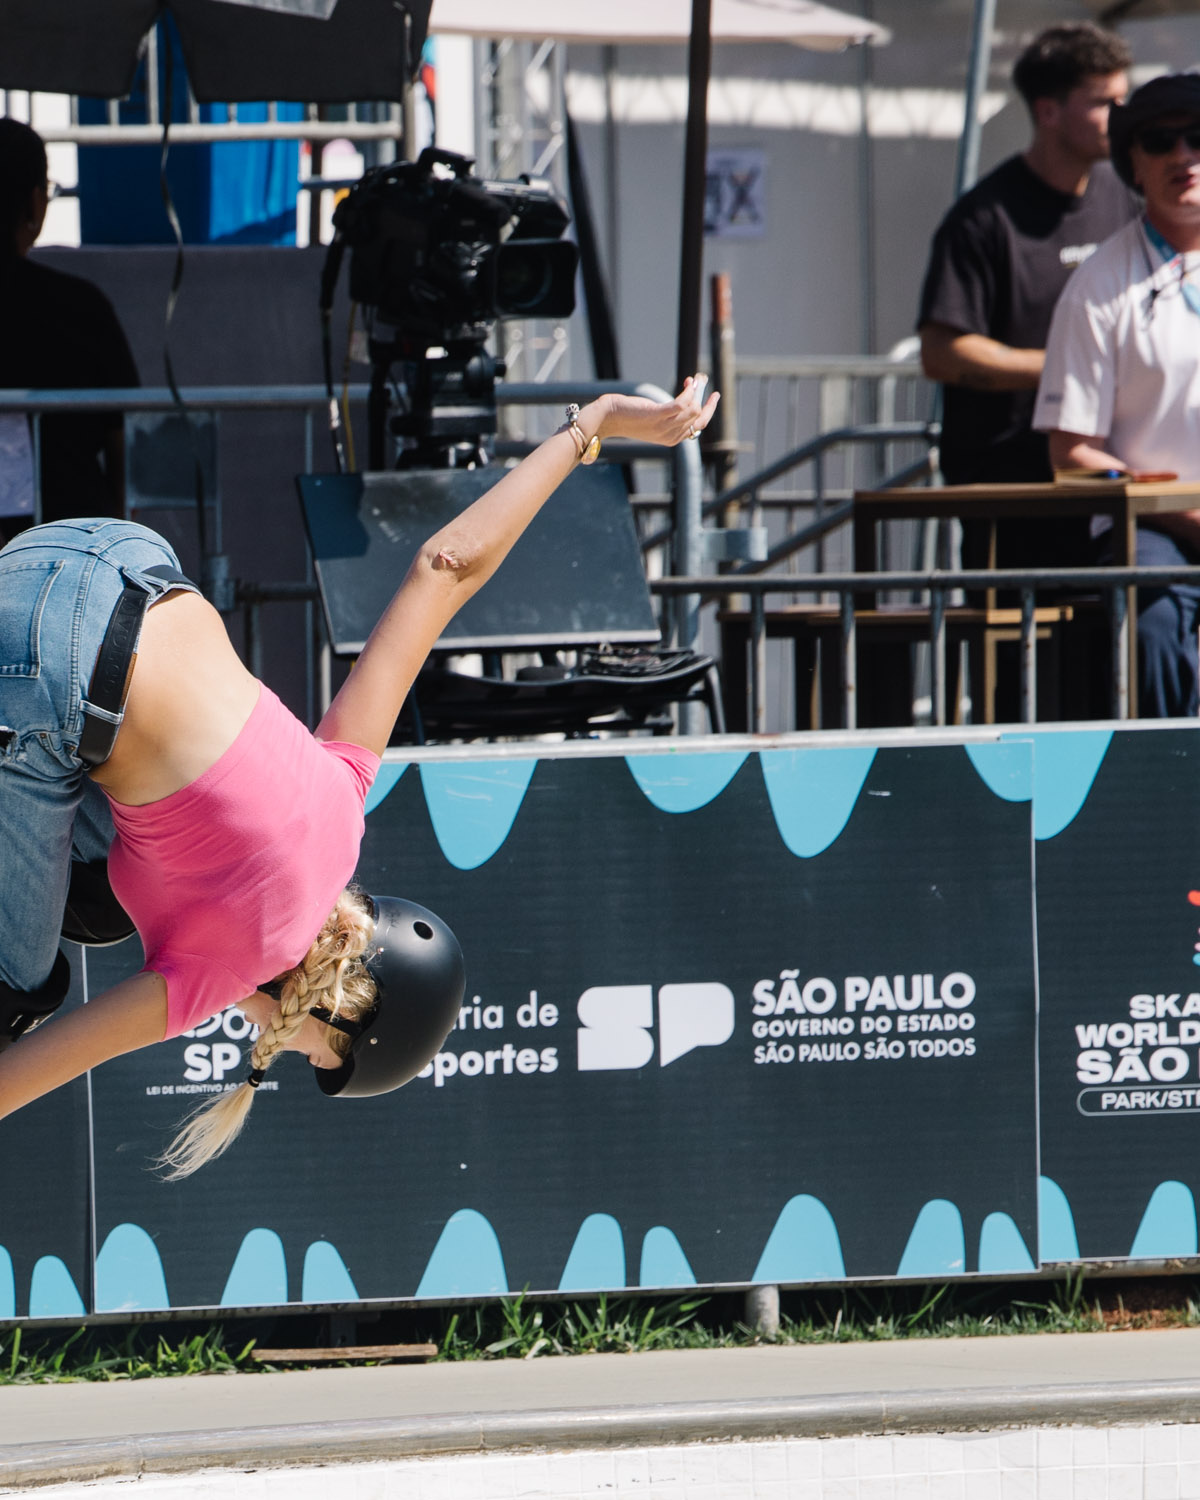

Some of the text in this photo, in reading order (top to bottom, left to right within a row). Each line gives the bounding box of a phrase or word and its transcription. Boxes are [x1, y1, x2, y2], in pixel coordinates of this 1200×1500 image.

[752, 969, 976, 1016] SÃO PAULO
[516, 990, 559, 1027] de
[752, 1013, 976, 1038] GOVERNO DO ESTADO
[1075, 1021, 1200, 1048] WORLD
[183, 1043, 241, 1082] SP
[754, 1037, 976, 1064] SÃO PAULO SÃO TODOS
[1076, 1047, 1190, 1084] SÃO
[162, 1085, 174, 1094] DE
[176, 1083, 222, 1094] INCENTIVO
[1101, 1090, 1200, 1110] PARK/ST
